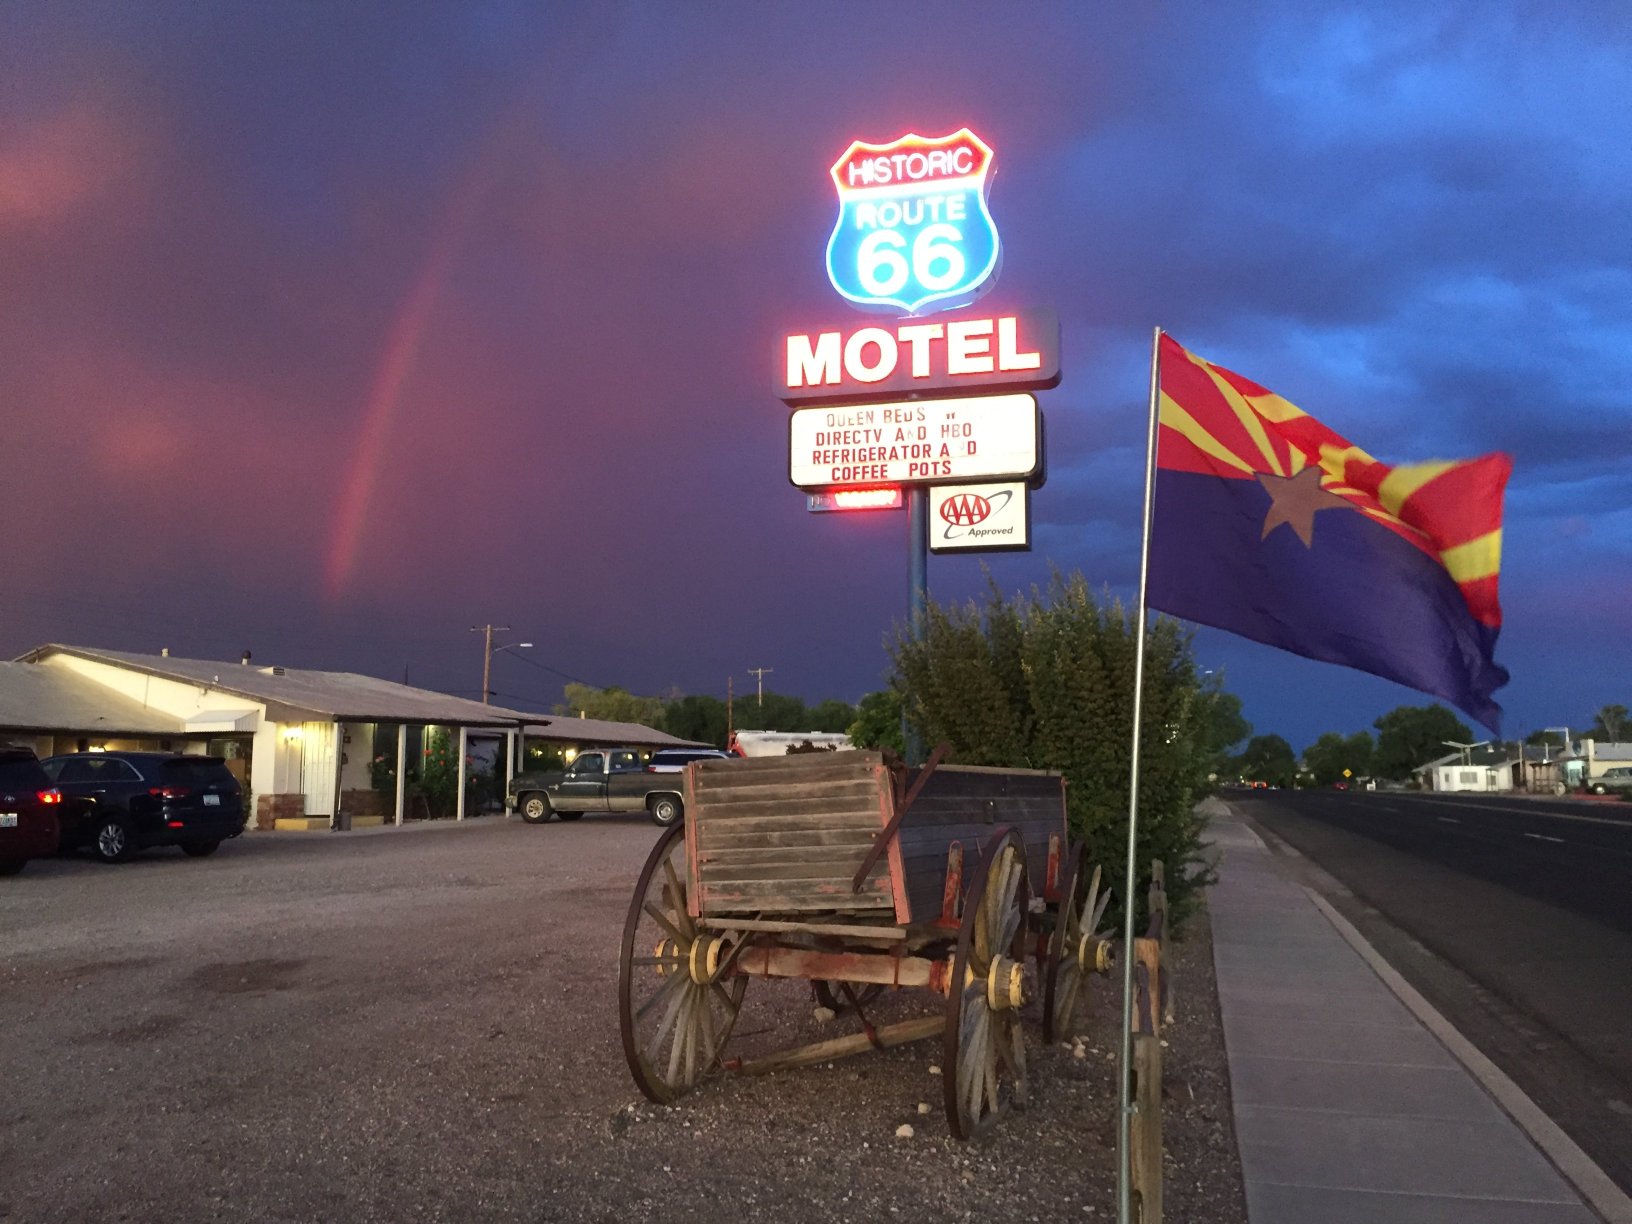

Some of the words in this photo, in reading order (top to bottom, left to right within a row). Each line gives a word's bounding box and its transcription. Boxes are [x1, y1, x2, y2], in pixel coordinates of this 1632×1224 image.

[849, 147, 973, 186] HISTORIC
[855, 193, 967, 230] ROUTE
[856, 223, 966, 297] 66
[786, 316, 1041, 387] MOTEL
[826, 410, 874, 427] QUEEN
[816, 428, 882, 447] DIRECTV
[941, 423, 972, 439] HBO
[812, 443, 932, 465] REFRIGERATOR
[939, 440, 977, 458] AD
[831, 463, 888, 482] COFFEE
[909, 459, 952, 477] POTS
[944, 494, 986, 526] AAA
[967, 525, 1014, 538] Approved
